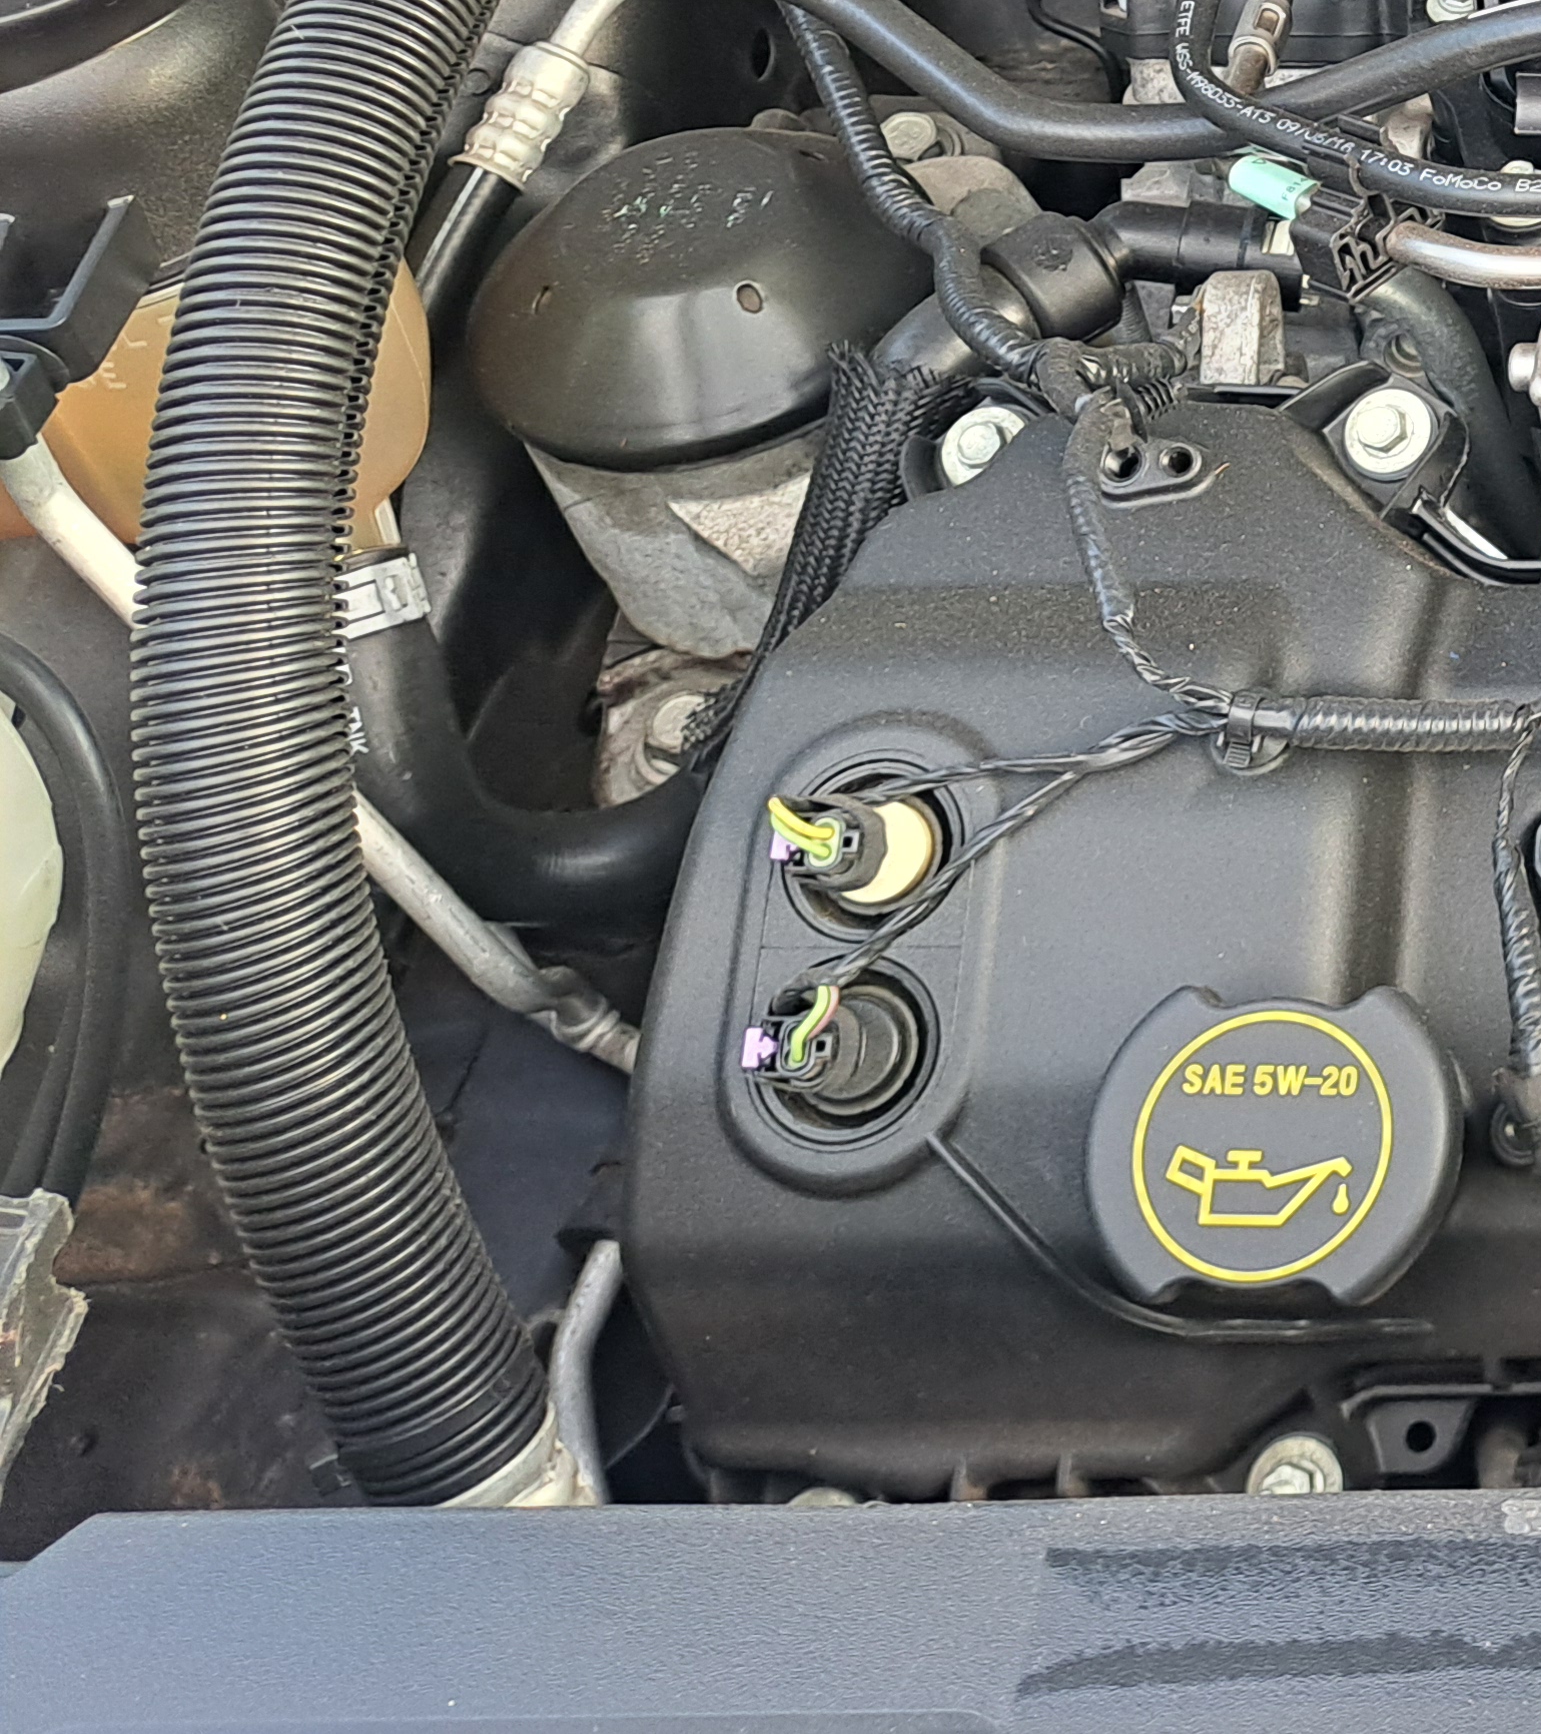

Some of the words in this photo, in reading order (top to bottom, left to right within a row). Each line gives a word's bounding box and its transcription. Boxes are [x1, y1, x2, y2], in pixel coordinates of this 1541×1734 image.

[1175, 0, 1195, 37] ETFE
[1360, 148, 1412, 177] 17:03
[1419, 168, 1502, 191] FoMoCo
[1181, 1063, 1245, 1096] SAE
[1252, 1063, 1360, 1097] 5W-20
